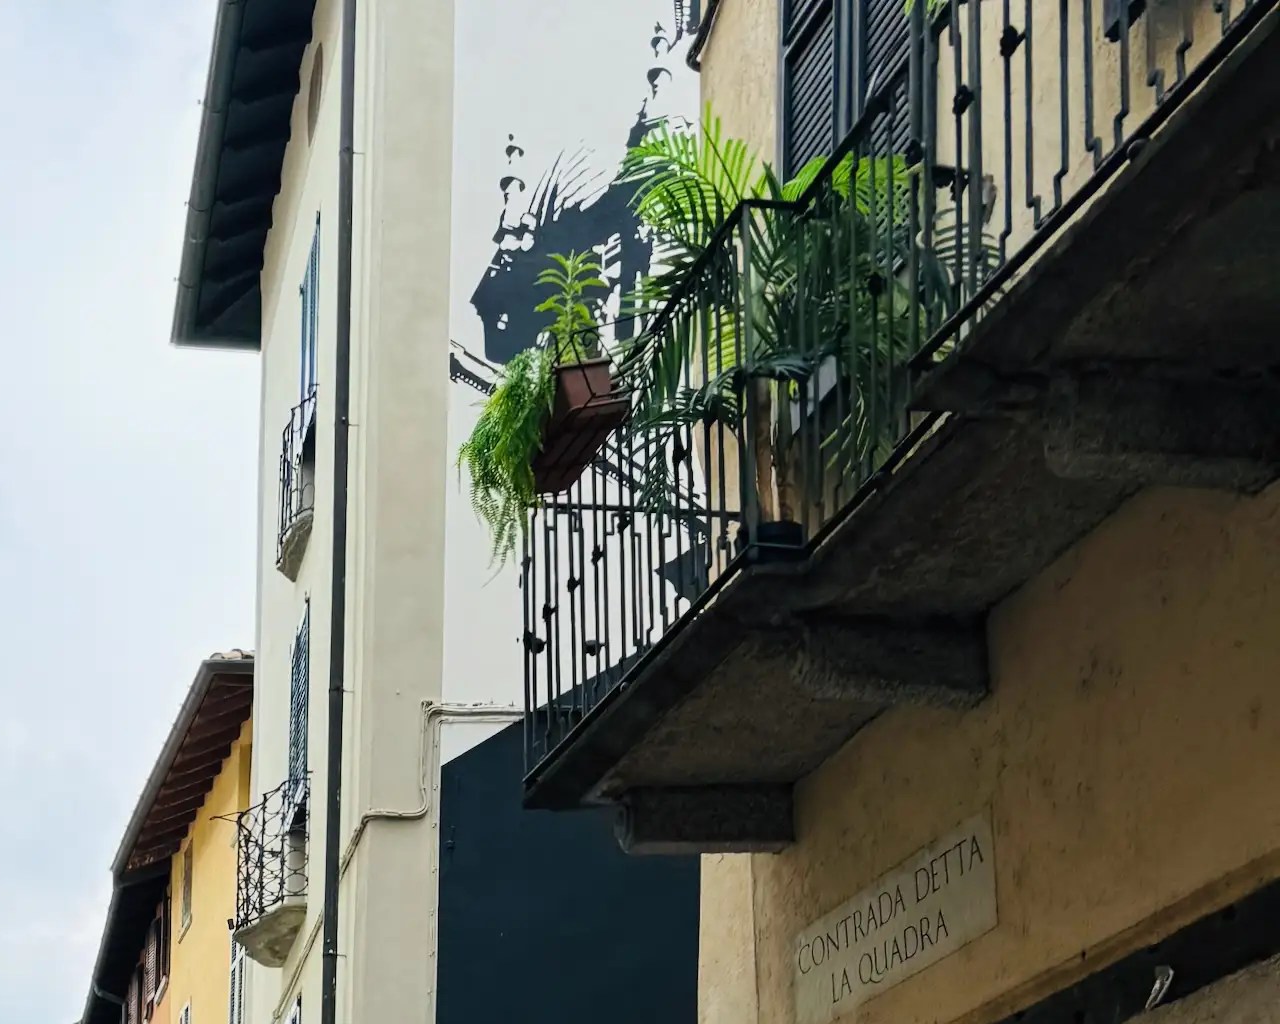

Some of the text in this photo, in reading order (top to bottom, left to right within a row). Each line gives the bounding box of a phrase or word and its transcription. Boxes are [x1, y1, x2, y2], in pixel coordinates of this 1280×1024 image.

[798, 834, 984, 975] CONTRADA DETTA
[831, 908, 949, 1003] LA QUADRA
